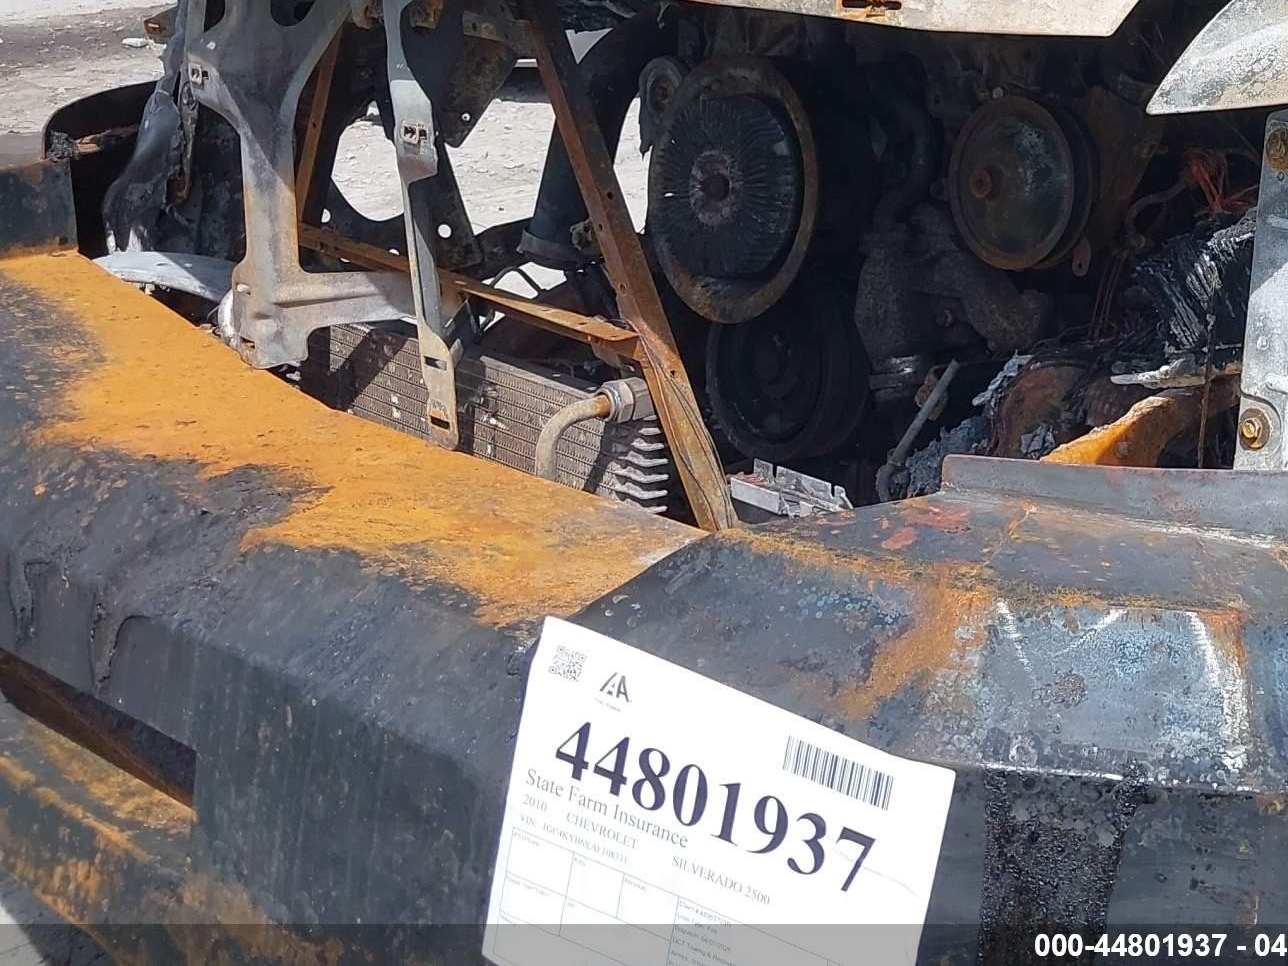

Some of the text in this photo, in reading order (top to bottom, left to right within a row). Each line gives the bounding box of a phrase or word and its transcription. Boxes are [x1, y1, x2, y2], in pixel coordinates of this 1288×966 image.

[522, 794, 548, 812] 2010
[566, 812, 640, 849] CHEVROLET
[672, 855, 743, 893] SILVERADO
[744, 884, 771, 906] 2500
[525, 768, 689, 848] State Farm Insurance
[555, 720, 878, 893] 44801937
